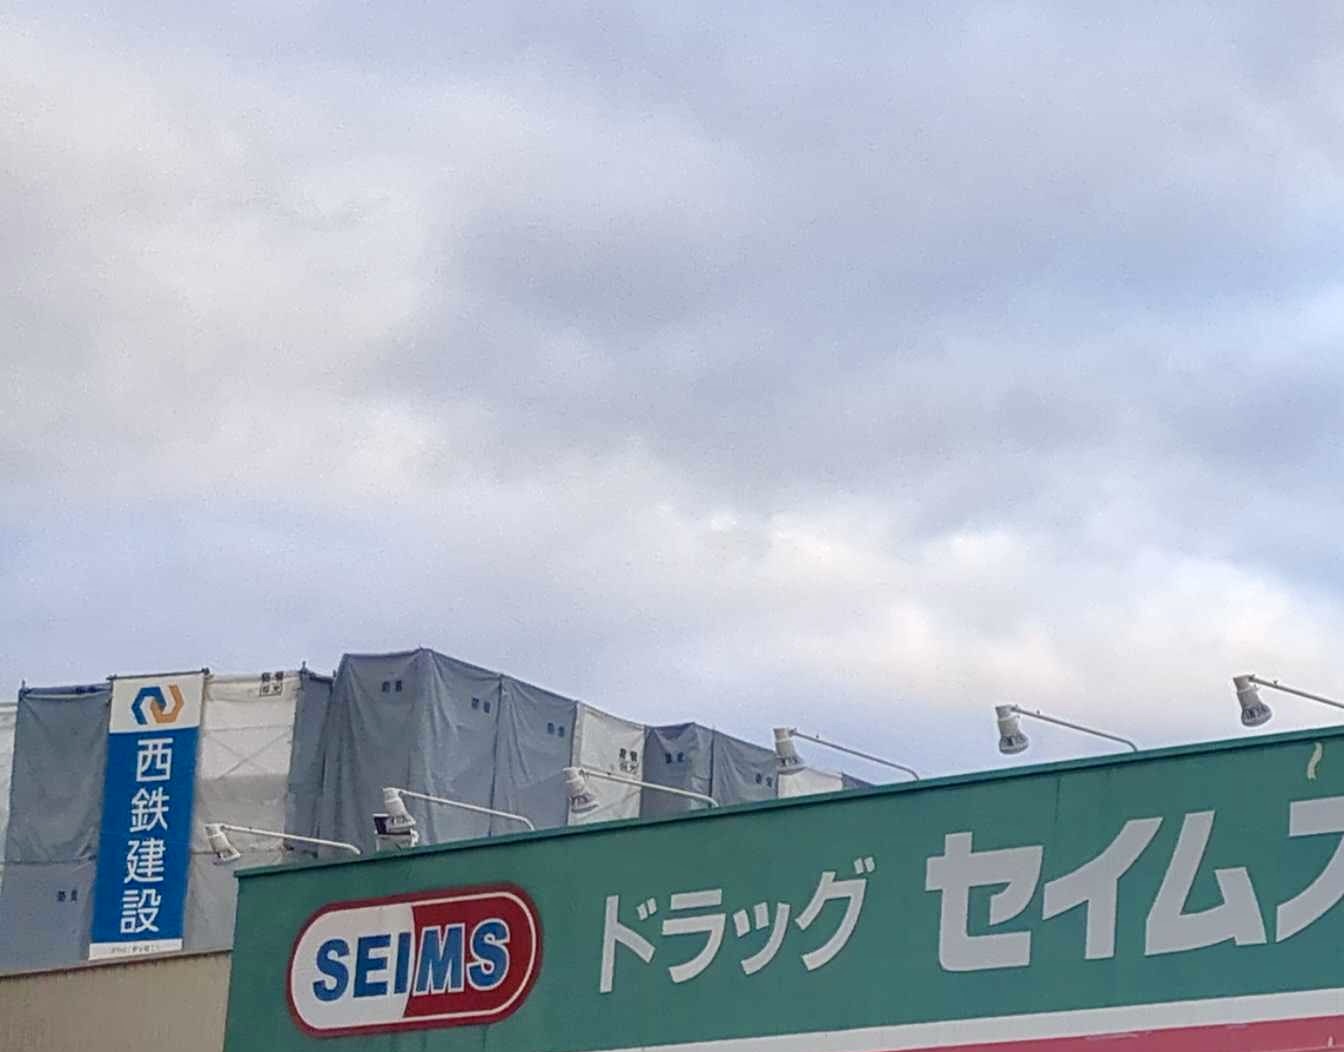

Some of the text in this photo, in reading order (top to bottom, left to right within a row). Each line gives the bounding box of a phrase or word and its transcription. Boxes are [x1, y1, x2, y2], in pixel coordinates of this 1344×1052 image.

[119, 736, 174, 934] 西鉄建設
[312, 917, 511, 1003] SEIMS
[600, 856, 877, 995] ドラッグ
